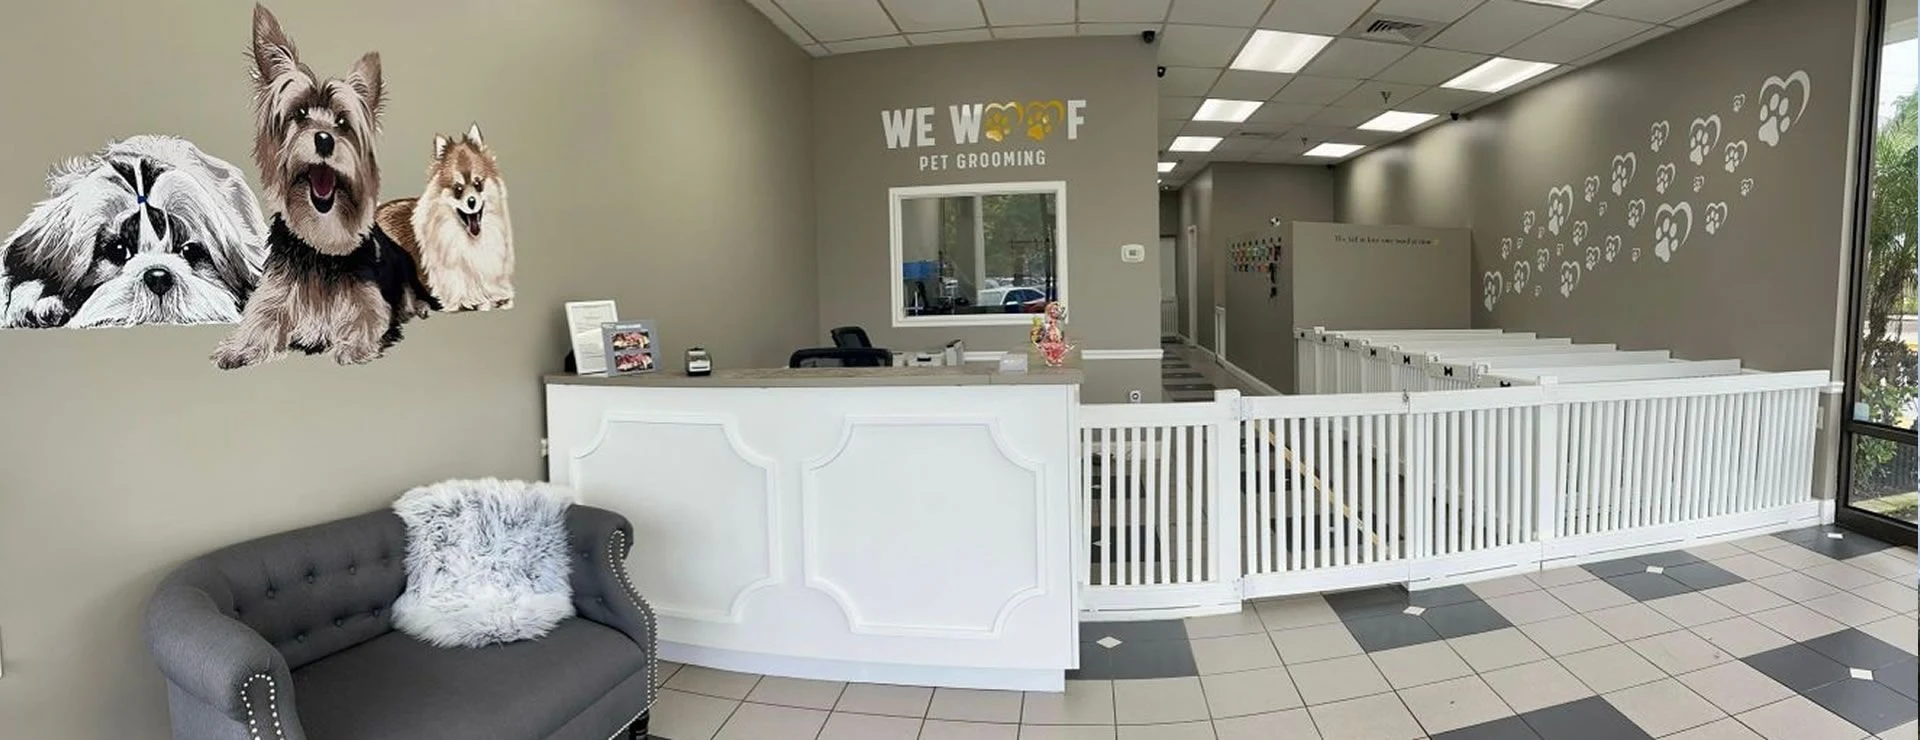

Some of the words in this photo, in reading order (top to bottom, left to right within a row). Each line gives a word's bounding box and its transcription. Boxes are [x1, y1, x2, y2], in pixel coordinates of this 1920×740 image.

[881, 106, 936, 149] WE
[919, 155, 949, 171] PET
[957, 150, 1046, 169] GROOMING
